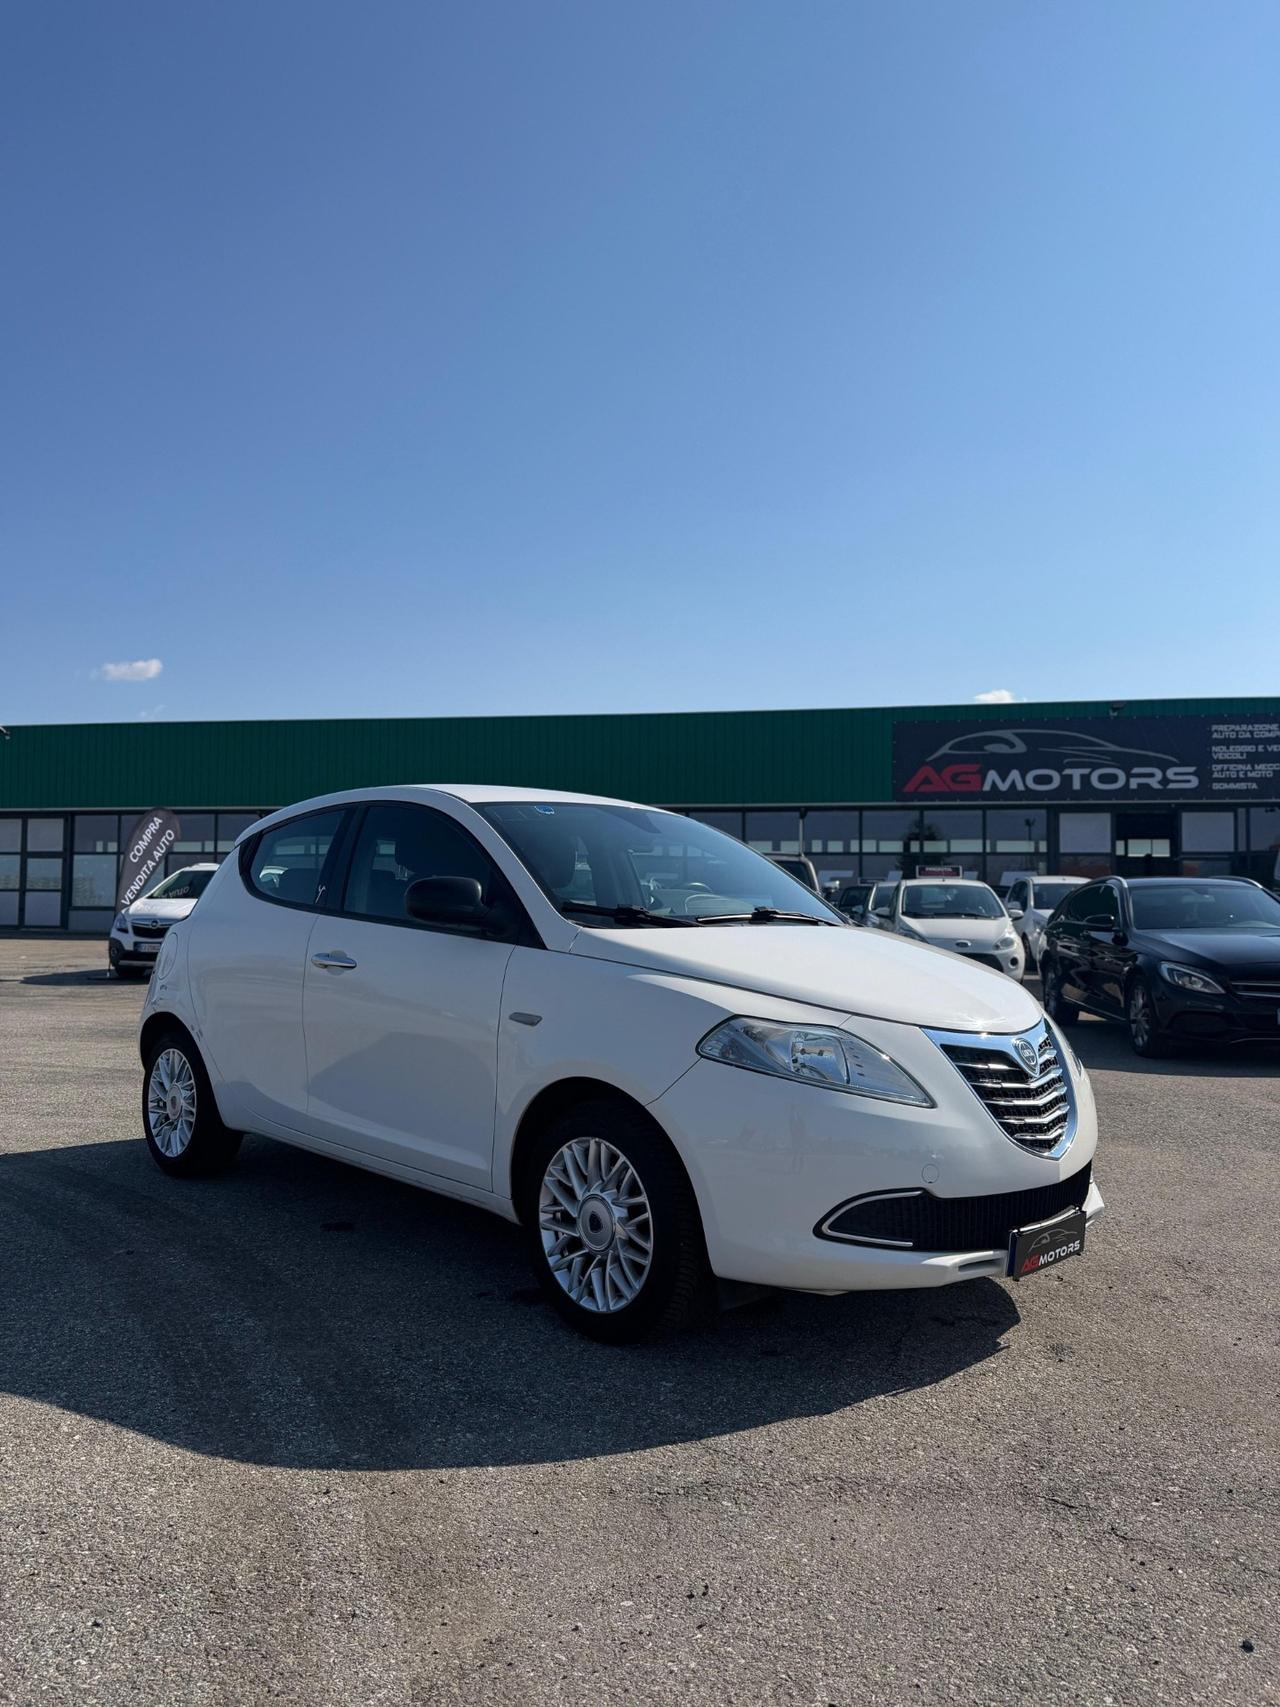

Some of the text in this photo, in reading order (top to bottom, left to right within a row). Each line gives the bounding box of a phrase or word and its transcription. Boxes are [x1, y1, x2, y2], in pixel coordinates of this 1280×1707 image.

[903, 764, 1199, 792] AGMOTORS
[129, 816, 164, 864] COMPRA
[121, 829, 175, 906] VENDITA AUTO
